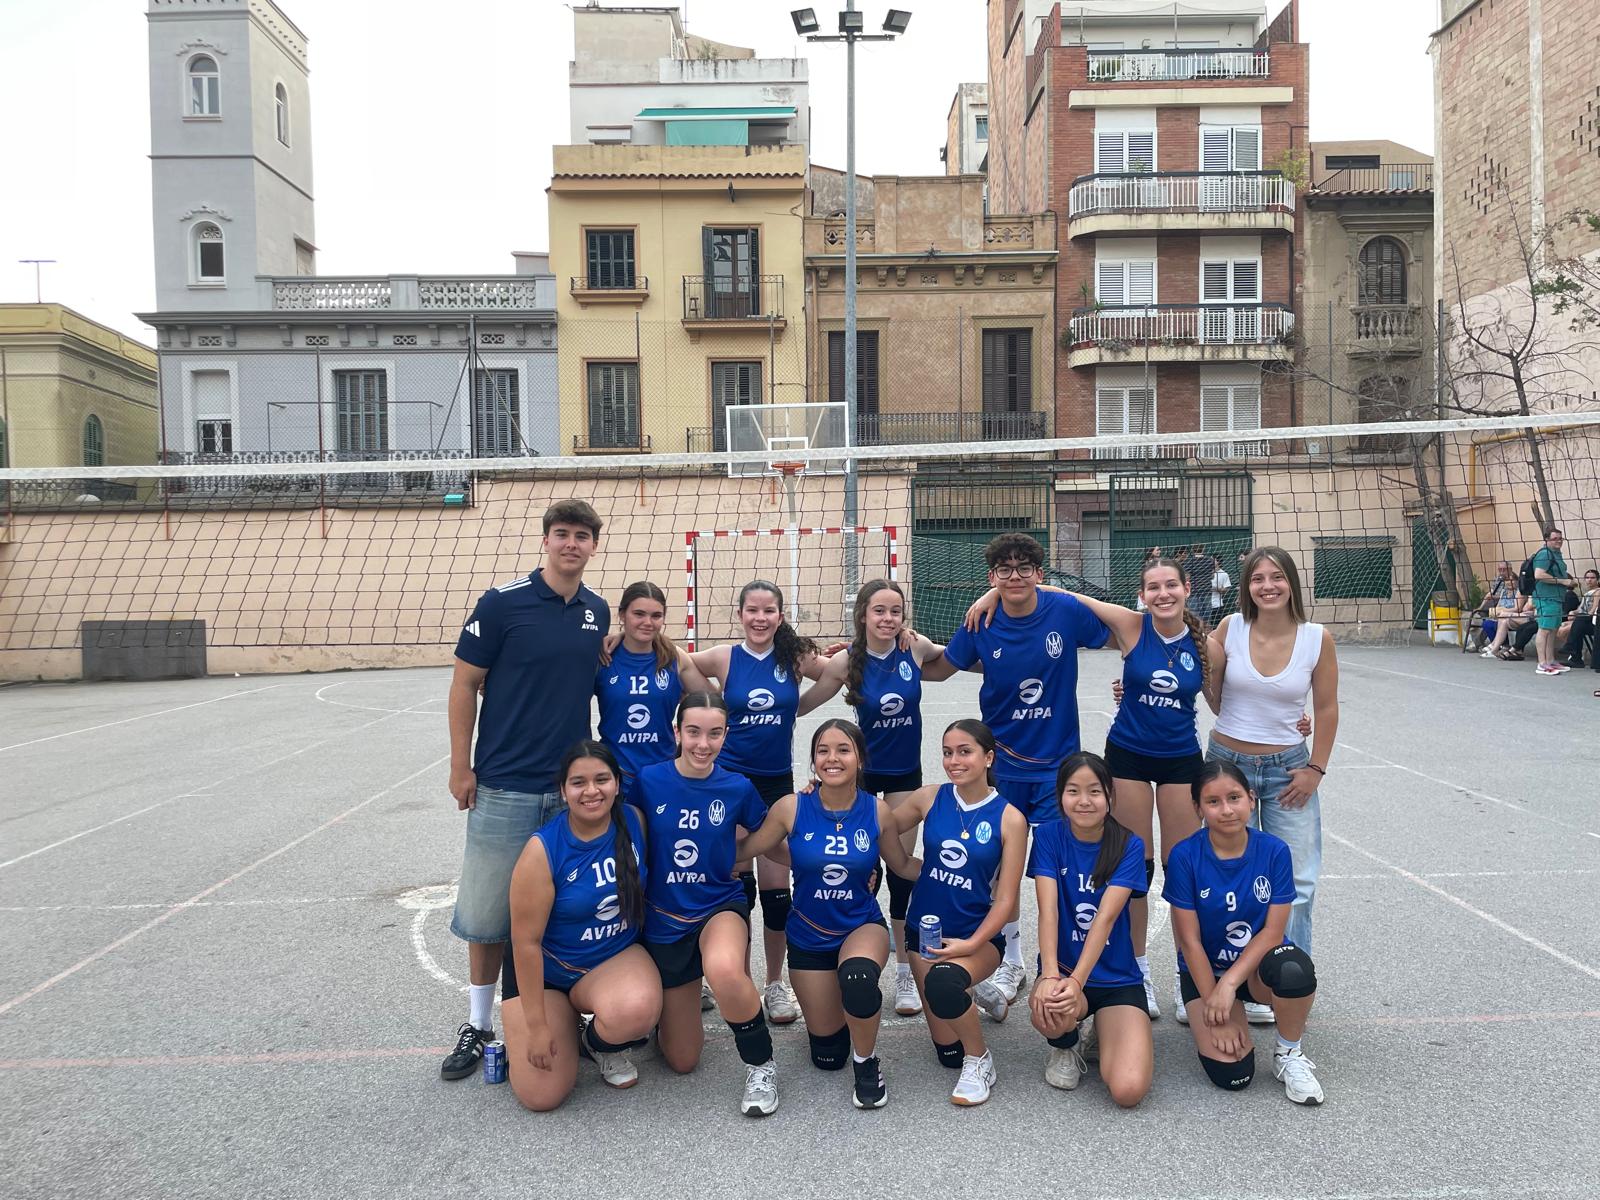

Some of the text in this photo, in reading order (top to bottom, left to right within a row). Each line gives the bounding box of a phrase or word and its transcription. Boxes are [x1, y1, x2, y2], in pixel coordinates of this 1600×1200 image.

[630, 676, 649, 695] 12
[1138, 693, 1182, 710] AVIPA
[679, 809, 699, 830] 26
[824, 836, 848, 855] 23
[592, 857, 617, 888] 10
[929, 867, 973, 891] AVIPA
[1078, 873, 1096, 894] 14
[814, 889, 853, 901] AVIPA
[1225, 891, 1237, 912] 9
